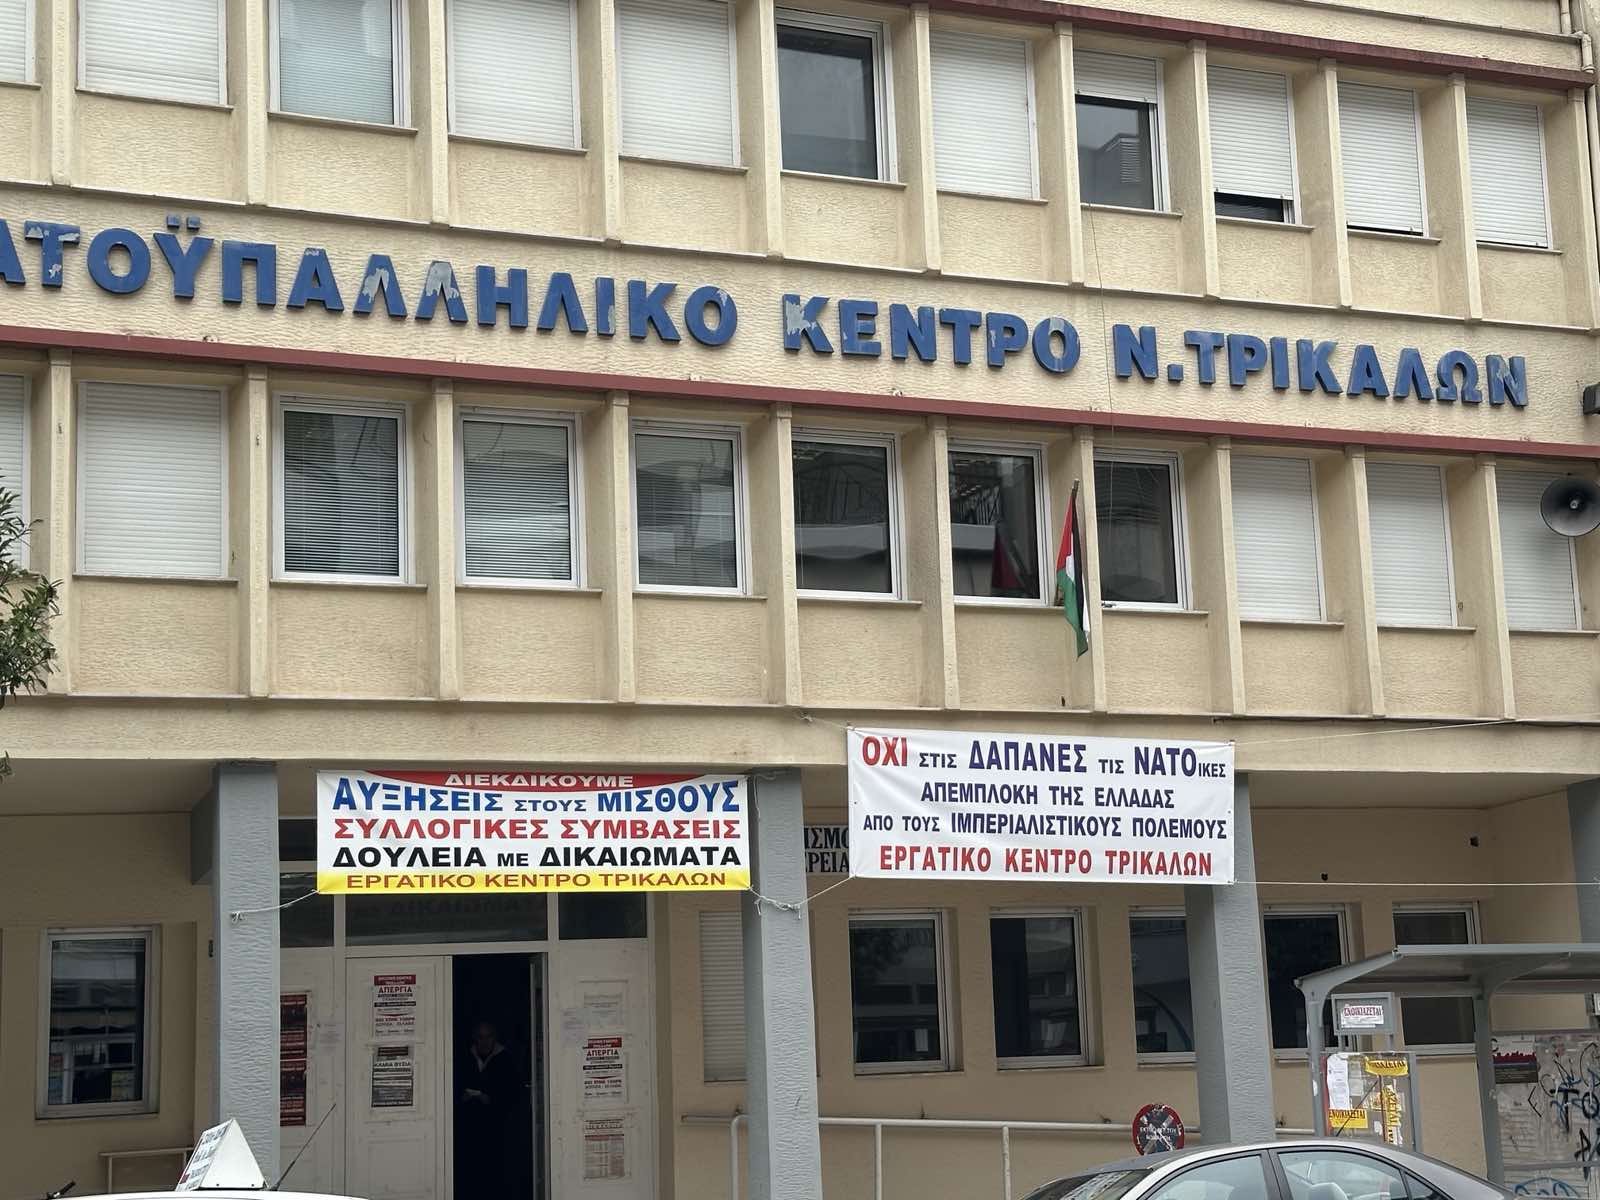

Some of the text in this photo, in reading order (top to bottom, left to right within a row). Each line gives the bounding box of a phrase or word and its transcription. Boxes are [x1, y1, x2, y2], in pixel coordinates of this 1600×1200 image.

[781, 293, 1081, 375] ΚΕΝΤΡΟ
[862, 736, 909, 768] ΟΧΙ
[918, 752, 958, 769] ΣΤΙΣ
[969, 740, 1087, 773] ΔΑΠΑΝΕΣ
[1098, 759, 1125, 774] ΤΙΣ
[444, 773, 634, 788] ΔΙΕΚΔΙΚΟΥΜΕ
[332, 777, 740, 813] ΑΥΞΗΣΕΙΣ ΣΤΟΥΣ ΜΙΣΘΟΥΣ
[921, 781, 1175, 809] ΑΠΕΜΠΛΟΚΗ ΤΗΣ ΕΛΛΑΔΑΣ
[334, 817, 740, 840] ΣΥΛΛΟΓΙΚΕΣ ΣΥΜΒΑΣΕΙΣ
[863, 812, 1227, 839] ΑΠΟ ΤΟΥΣ ΙΜΠΕΡΙΑΛΙΣΤΙΚΟΥΣ ΠΟΛΕΜΟΥΣ
[332, 846, 741, 868] ΔΟΥΛΕΙΑ ΜΕ ΔΙΚΑΙΩΜΑΤΑ
[804, 851, 849, 873] ΡΕΙΑ
[880, 845, 1212, 876] ΕΡΓΑΤΙΚΟ ΚΕΝΤΡΟ ΤΡΙΚΑΛΩΝ
[346, 872, 726, 889] ΕΡΓΑΤΙΚΟ ΚΕΝΤΡΟ ΤΡΙΚΑΛΩΝ
[378, 986, 412, 994] ΑΠΕΡΓΙΑ
[586, 1049, 619, 1057] ΑΠΕΡΓΙΑ
